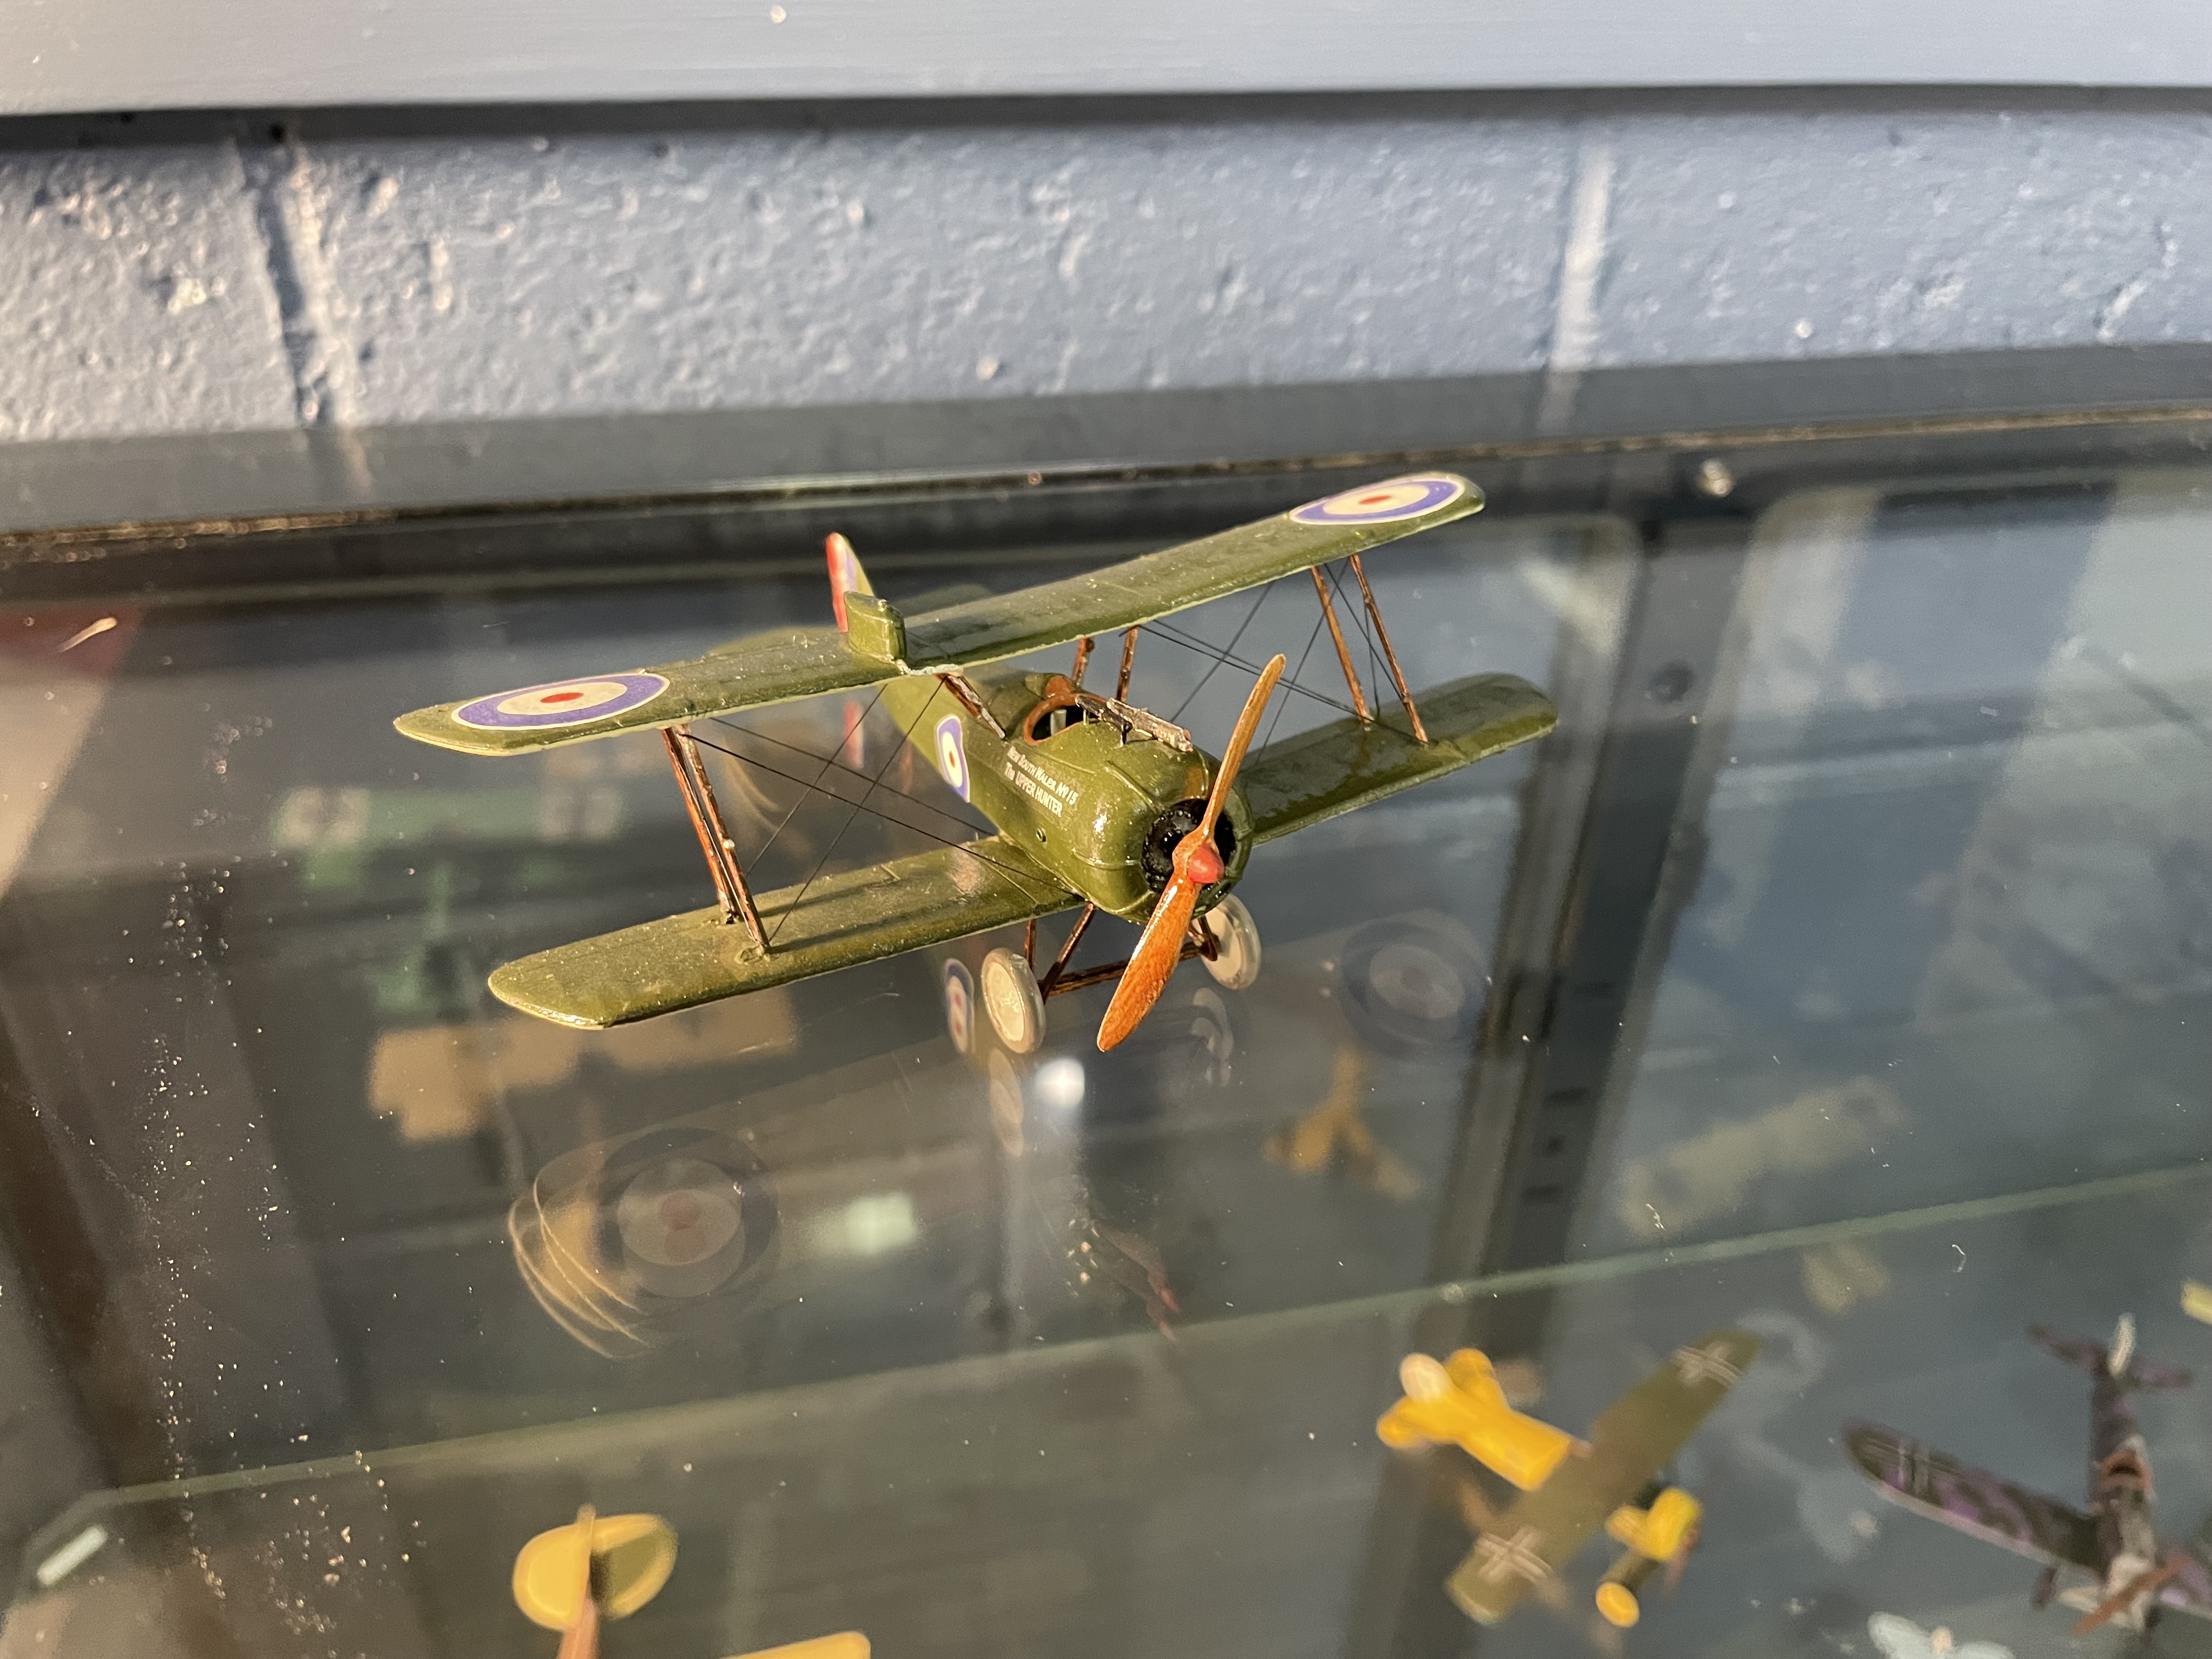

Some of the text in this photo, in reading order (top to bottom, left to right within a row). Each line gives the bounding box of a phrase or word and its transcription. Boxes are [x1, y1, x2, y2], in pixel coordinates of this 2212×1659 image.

[1015, 771, 1036, 798] UPPER
[1035, 786, 1063, 817] HUNTER
[1018, 754, 1037, 776] SOUTH
[1066, 790, 1079, 805] 15
